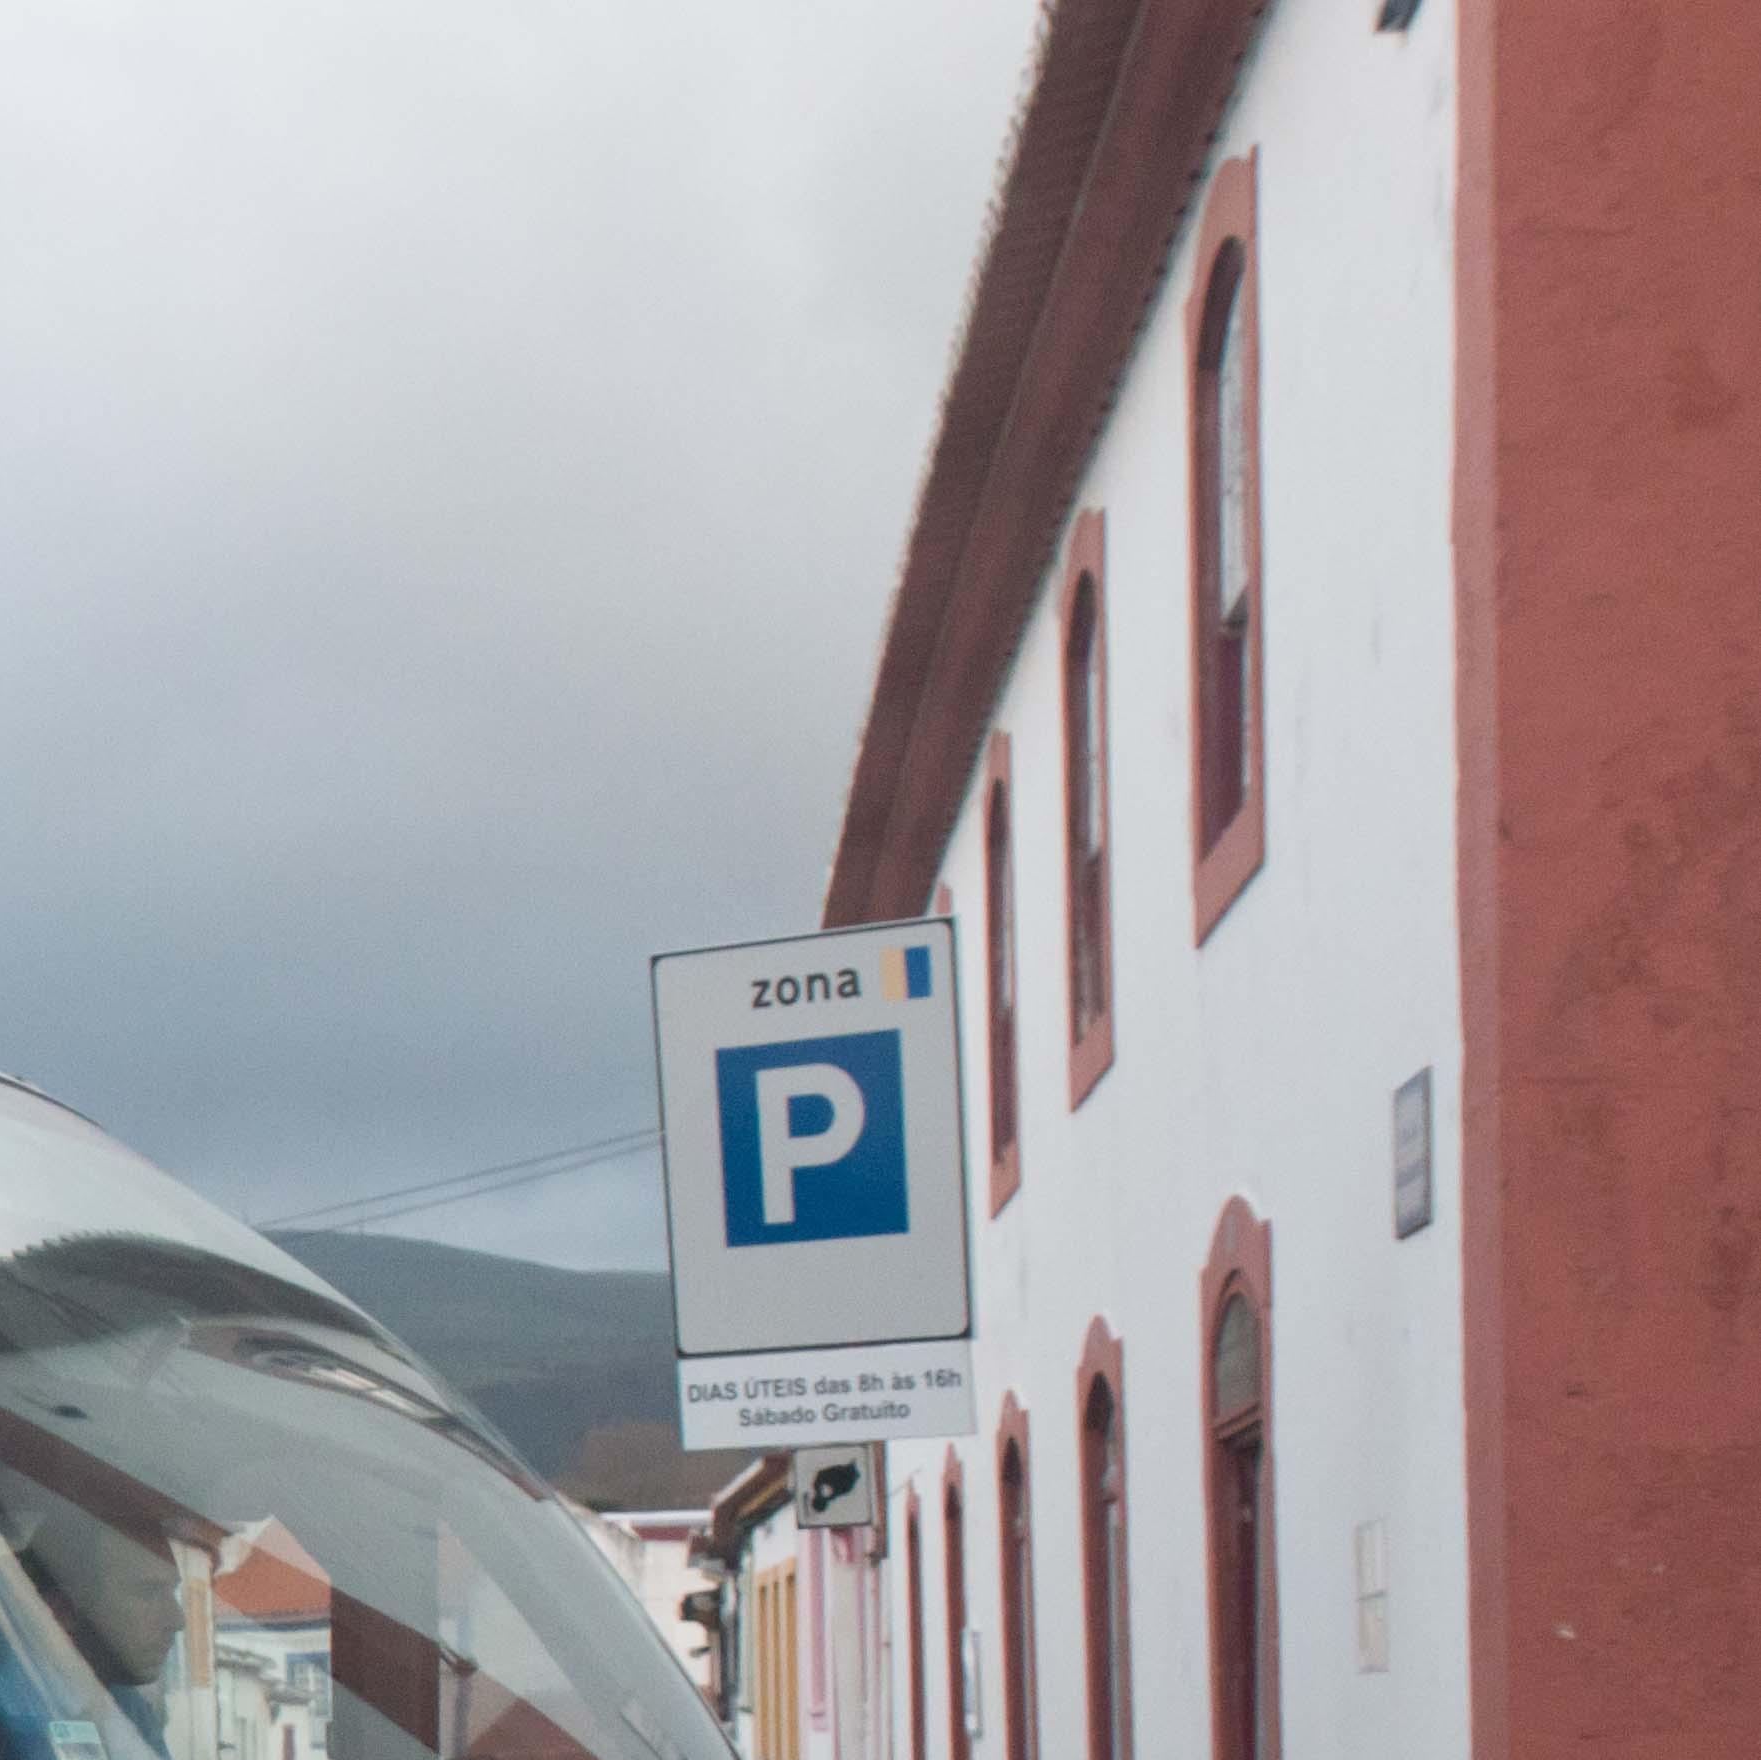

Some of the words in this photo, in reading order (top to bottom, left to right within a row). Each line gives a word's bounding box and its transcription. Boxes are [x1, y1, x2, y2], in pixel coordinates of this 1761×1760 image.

[751, 967, 861, 1009] zona
[755, 1061, 867, 1225] P
[687, 1381, 738, 1404] DIAS
[743, 1374, 808, 1400] ÚTEIS
[814, 1375, 851, 1397] das
[858, 1372, 885, 1393] 8h
[923, 1368, 962, 1389] 16h
[739, 1405, 817, 1427] Sábado
